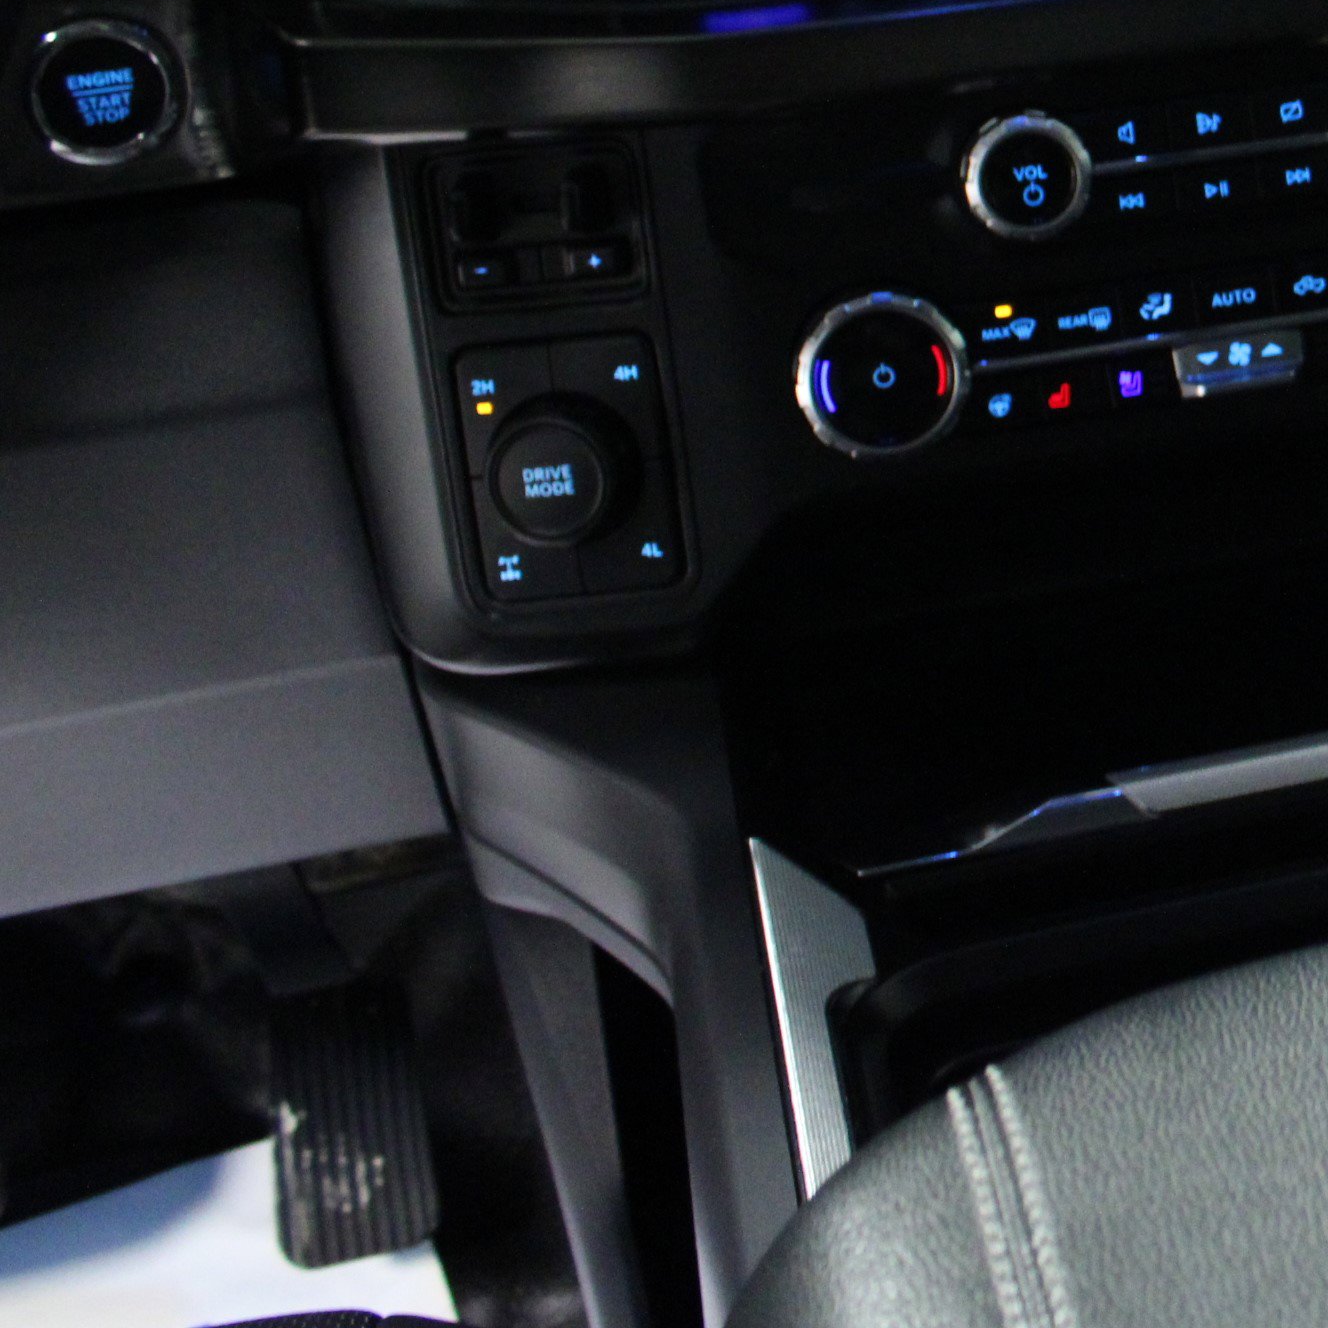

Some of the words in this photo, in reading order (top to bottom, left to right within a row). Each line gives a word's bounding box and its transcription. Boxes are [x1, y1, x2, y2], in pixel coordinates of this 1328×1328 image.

[66, 68, 133, 90] ENGINE
[77, 92, 130, 112] START
[82, 107, 130, 127] STOP
[1013, 164, 1047, 181] VOL
[1212, 288, 1256, 308] AUTO
[1058, 314, 1088, 329] REAR
[982, 327, 1010, 341] MAX
[613, 365, 638, 381] 4H
[471, 379, 495, 396] 2H
[523, 464, 572, 483] DRIVE
[525, 479, 574, 497] MODE
[641, 542, 663, 558] 4L
